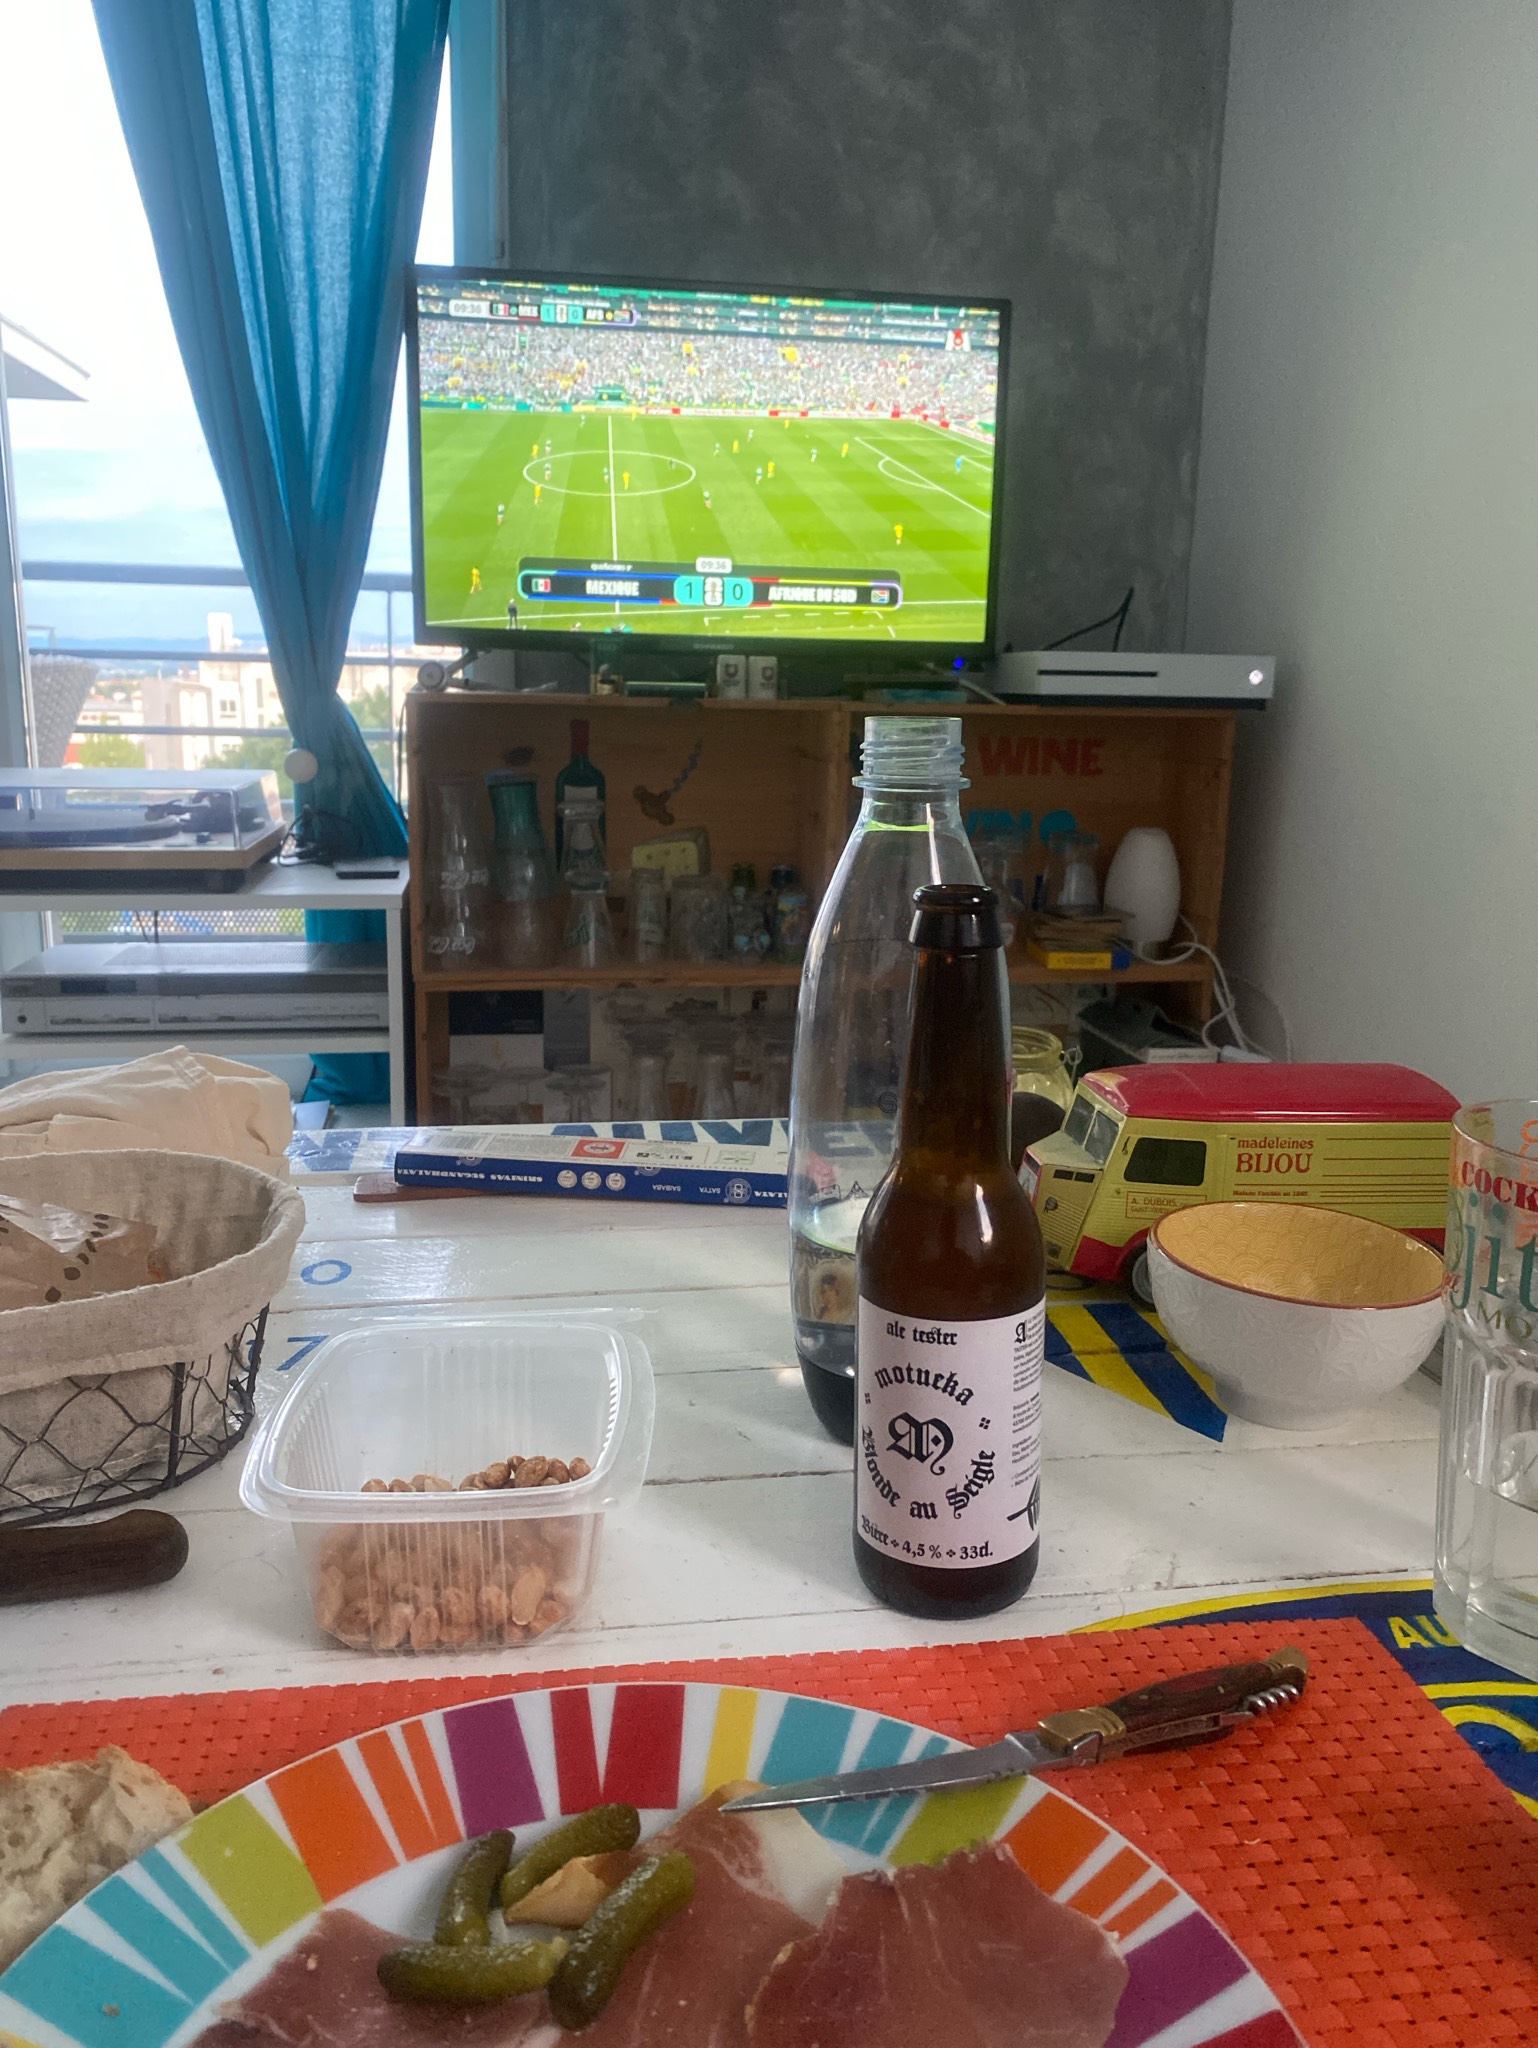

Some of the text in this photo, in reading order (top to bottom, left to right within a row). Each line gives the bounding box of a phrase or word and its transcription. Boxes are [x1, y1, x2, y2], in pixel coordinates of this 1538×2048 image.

[585, 579, 640, 598] MEXIQUE
[686, 581, 693, 600] 1
[732, 582, 744, 601] 0
[768, 585, 816, 602] AFRIQUE
[977, 736, 1105, 777] WINE
[1237, 1136, 1315, 1150] madeleines
[1235, 1152, 1314, 1175] BIJOU
[699, 1185, 721, 1195] SATYA
[886, 1320, 958, 1346] ale tester
[874, 1362, 974, 1406] motueka
[861, 1425, 901, 1508] Blonde
[909, 1500, 938, 1520] au
[945, 1449, 996, 1520] Seigle
[861, 1514, 889, 1546] Bière
